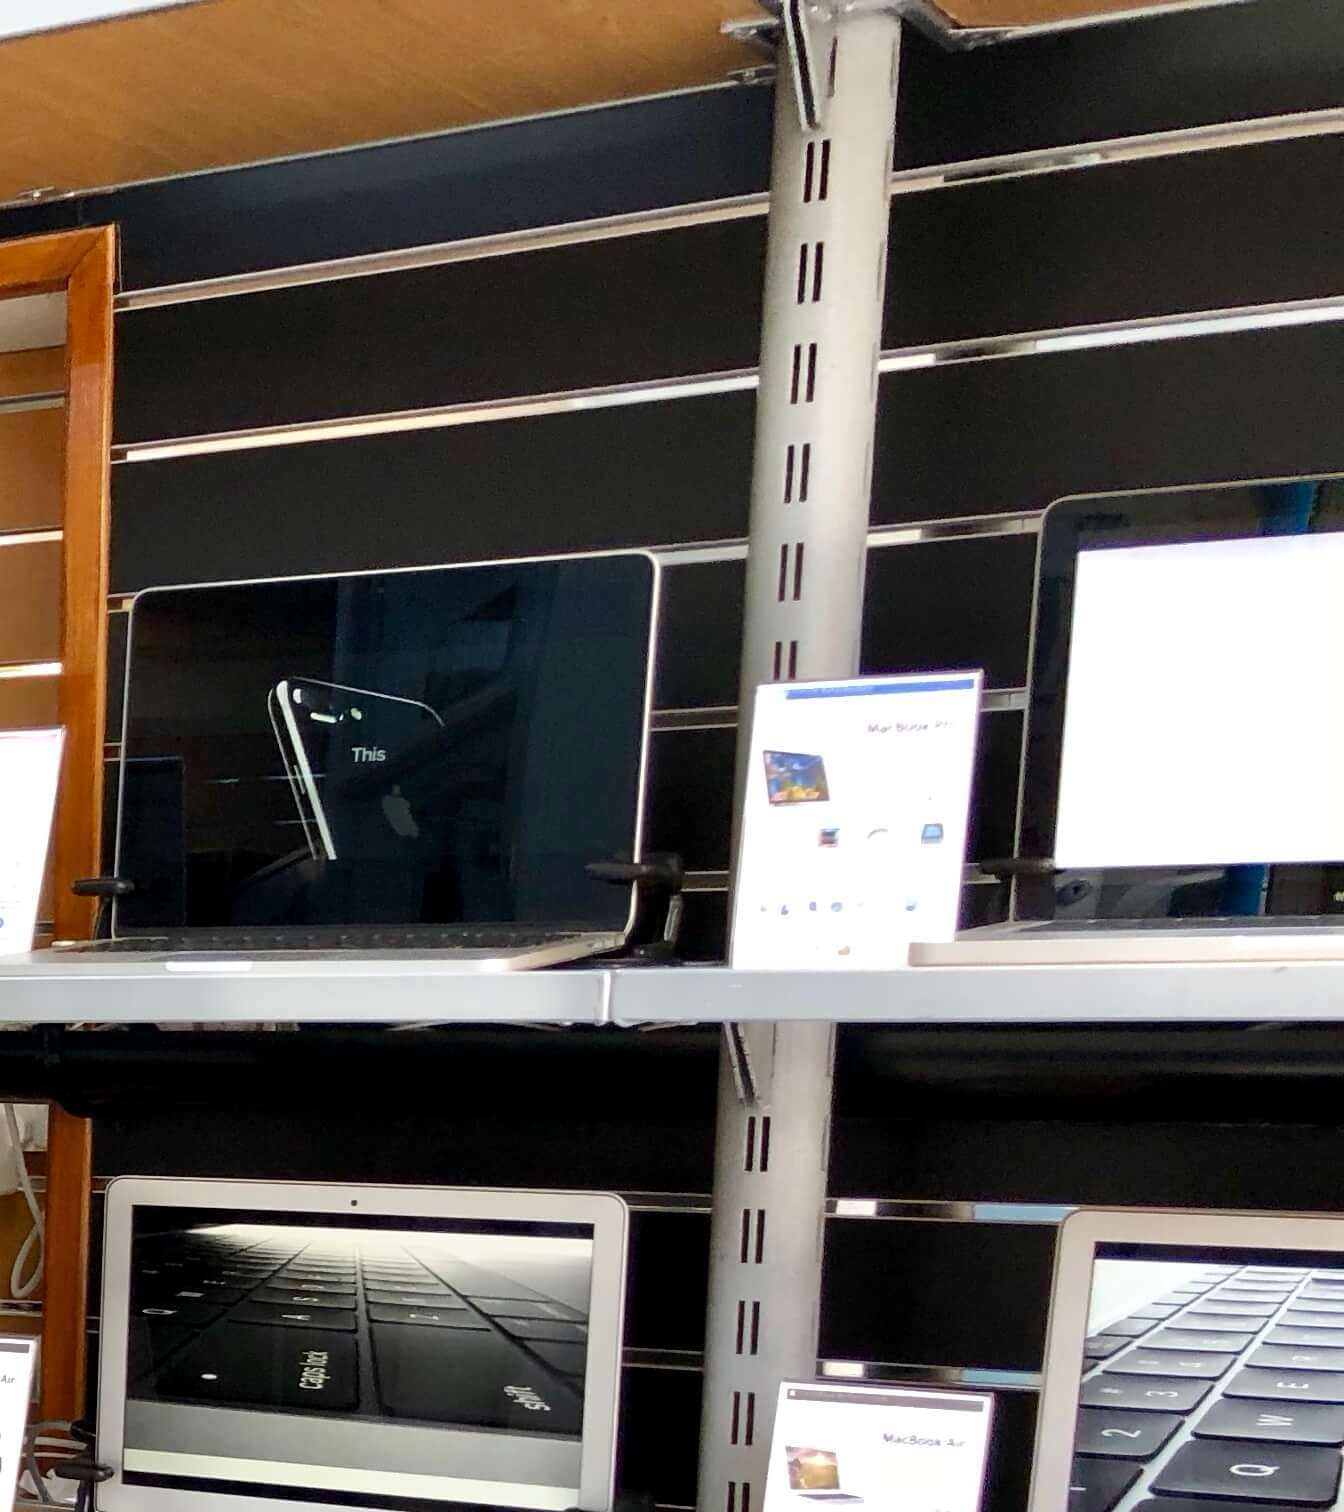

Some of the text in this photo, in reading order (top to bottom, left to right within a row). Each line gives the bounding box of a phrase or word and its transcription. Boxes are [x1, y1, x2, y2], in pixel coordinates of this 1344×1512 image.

[351, 746, 386, 763] This
[298, 1351, 332, 1390] caps lock
[0, 1375, 16, 1384] Air
[1276, 1380, 1310, 1390] E
[503, 1384, 551, 1413] shift
[1255, 1413, 1295, 1428] W
[1101, 1427, 1142, 1439] 2
[1229, 1462, 1281, 1478] Q
